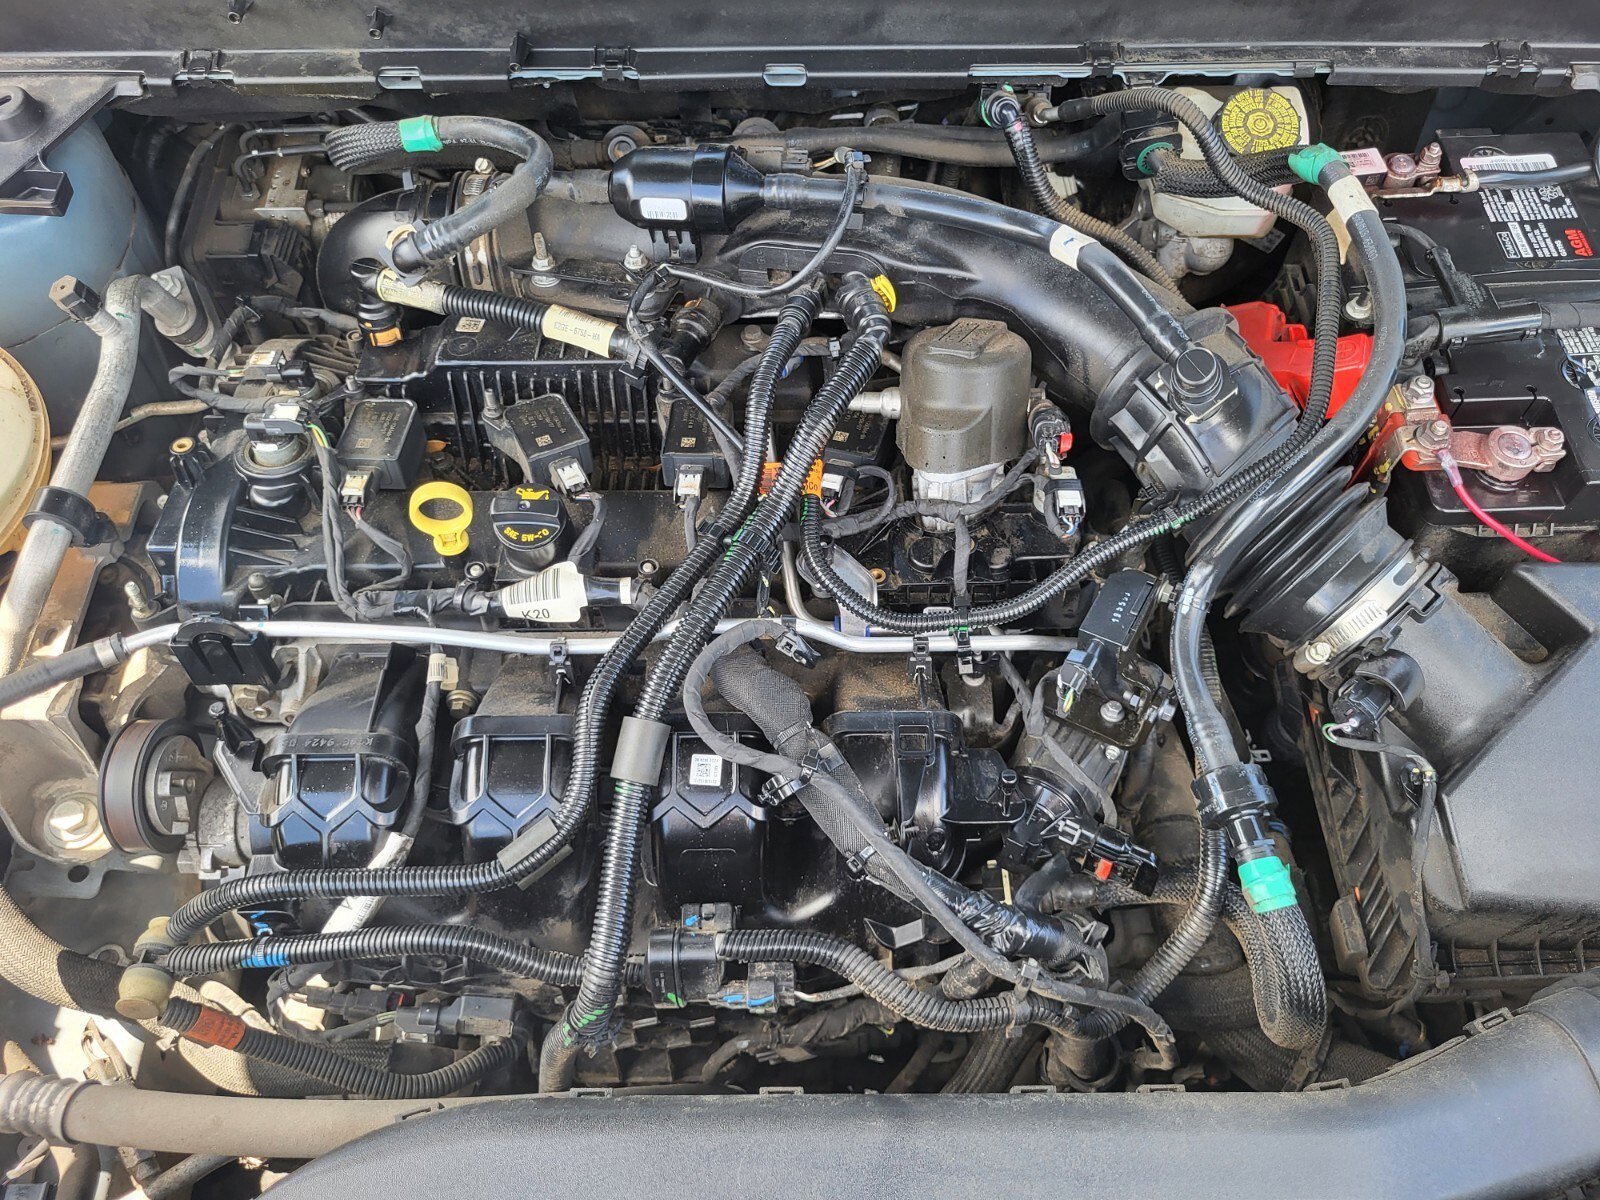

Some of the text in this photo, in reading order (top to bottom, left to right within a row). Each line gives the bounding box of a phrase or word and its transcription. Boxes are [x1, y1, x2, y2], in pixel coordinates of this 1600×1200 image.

[1501, 233, 1517, 258] FoMoCo
[1564, 229, 1586, 256] AGM
[504, 526, 519, 540] SAE
[521, 608, 550, 619] K20
